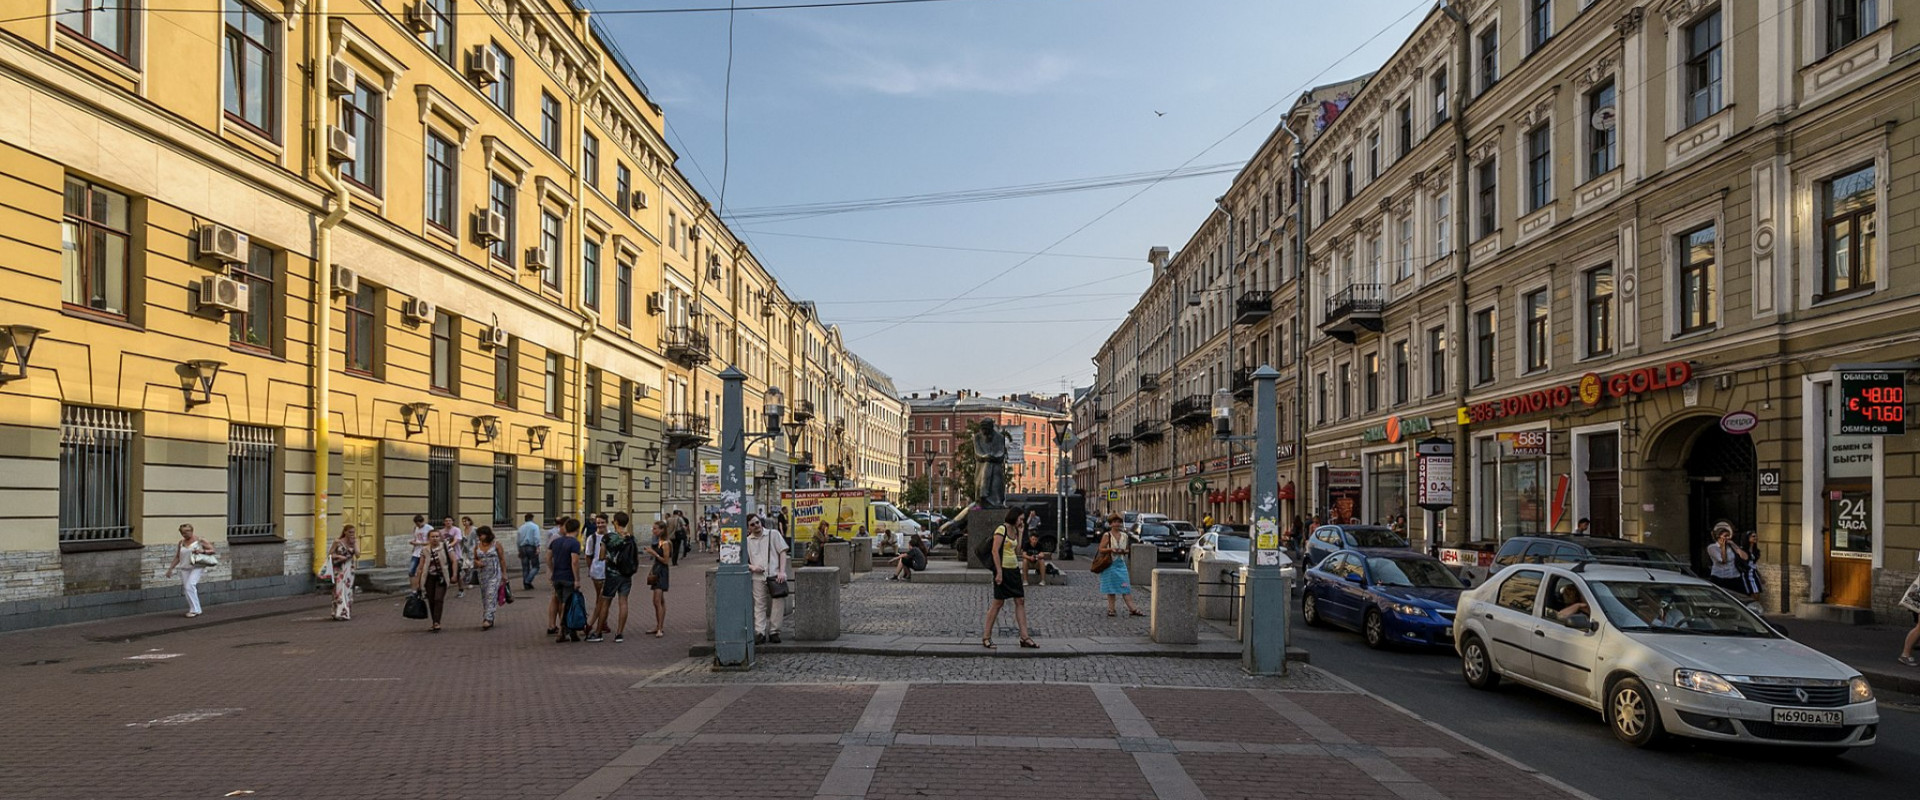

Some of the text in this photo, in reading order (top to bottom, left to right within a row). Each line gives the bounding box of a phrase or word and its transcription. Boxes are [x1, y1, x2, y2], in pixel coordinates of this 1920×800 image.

[1470, 402, 1495, 422] 585
[1500, 385, 1572, 417] ЗОЛОТО
[1608, 361, 1692, 398] GOLD
[1862, 387, 1903, 403] 48.00
[1862, 406, 1903, 421] 47.60
[1842, 425, 1888, 433] ОБМЕН СКВ
[1518, 432, 1544, 445] 585
[1832, 443, 1860, 452] ОБМЕН
[793, 506, 824, 517] КНИГИ
[1838, 499, 1867, 520] 24
[1838, 520, 1868, 530] ЧАСА
[1441, 551, 1458, 562] ЦЕНА
[1777, 711, 1840, 723] М690ВА 178
